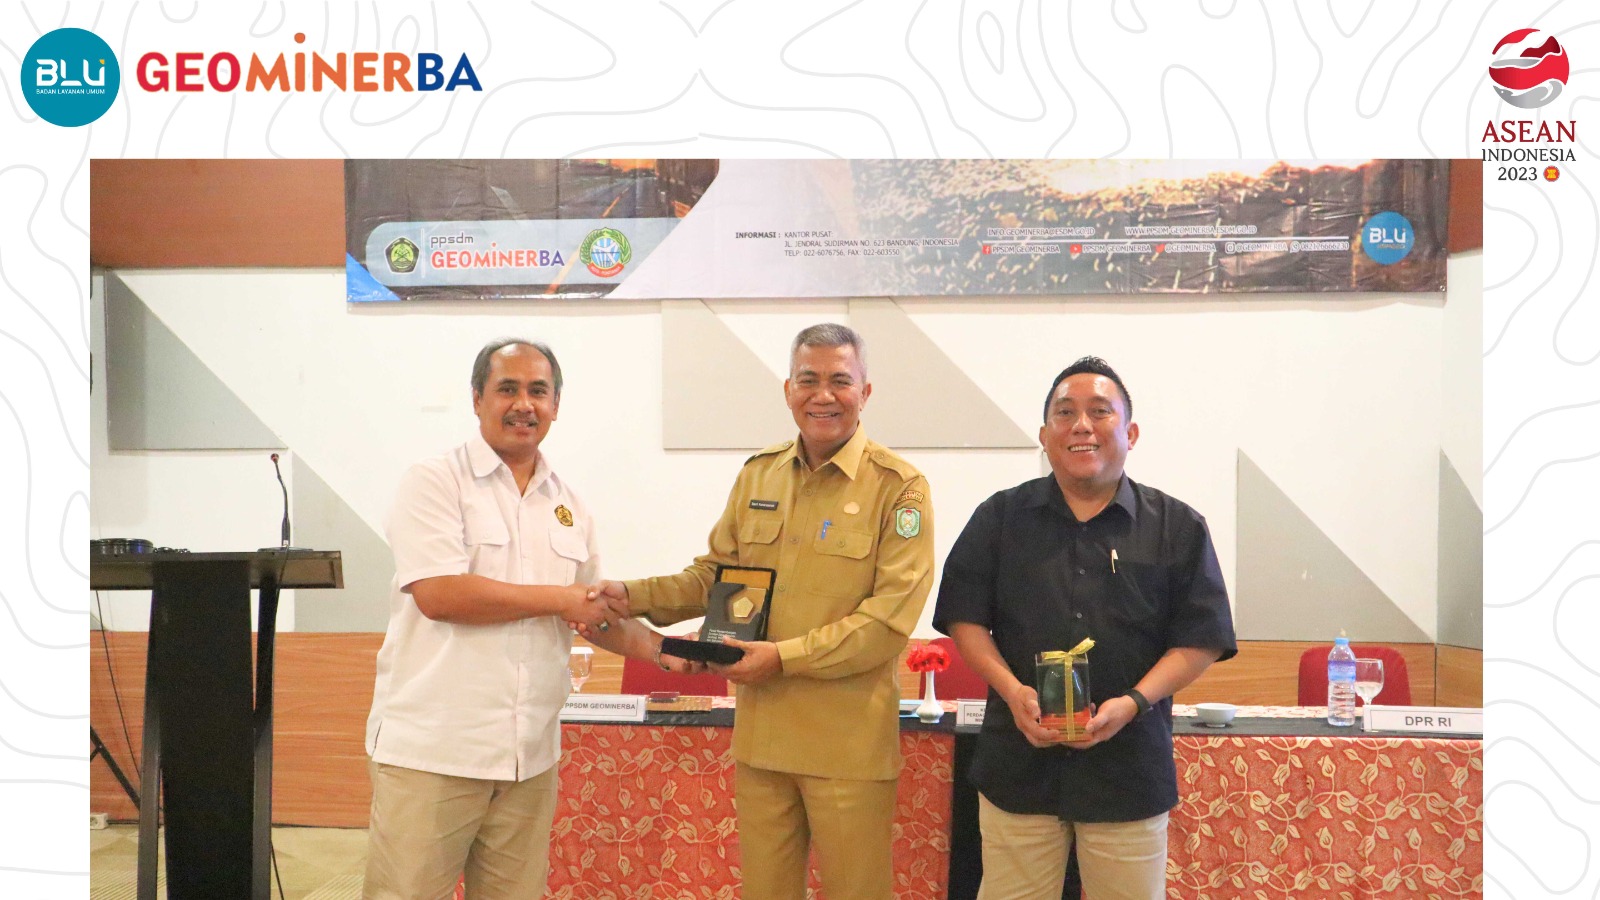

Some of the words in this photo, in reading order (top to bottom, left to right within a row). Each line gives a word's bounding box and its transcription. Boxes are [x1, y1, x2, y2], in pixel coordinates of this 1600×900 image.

[430, 232, 474, 248] ppsdm
[1369, 227, 1406, 243] BLU
[794, 240, 822, 248] JENDRAL
[922, 238, 959, 246] INDONESIA
[1082, 244, 1106, 252] PPSDM
[1107, 244, 1151, 252] GEOMINERBA
[992, 245, 1015, 253] PPSDM
[1016, 244, 1060, 253] GEOMINERBA
[1405, 716, 1434, 727] DPR
[1438, 717, 1452, 727] RI
